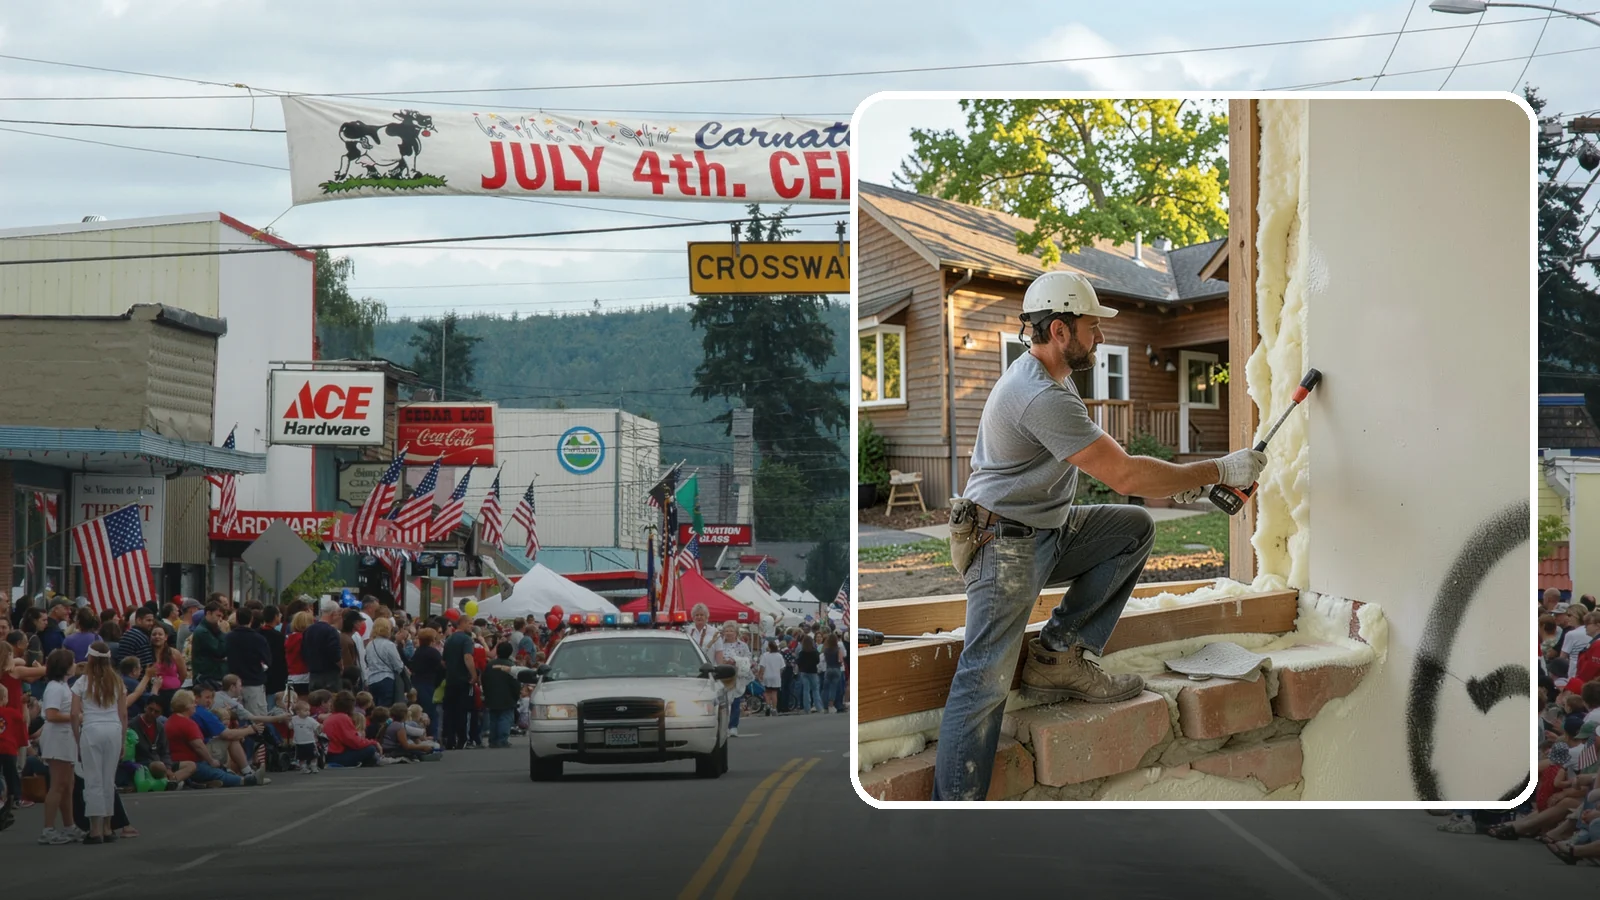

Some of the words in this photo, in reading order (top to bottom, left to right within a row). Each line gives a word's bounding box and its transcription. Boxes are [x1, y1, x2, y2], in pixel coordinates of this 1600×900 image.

[695, 121, 850, 150] Carnat
[481, 141, 605, 192] JULY
[632, 150, 746, 197] 4th.
[697, 254, 850, 280] CROSSWA
[283, 380, 373, 420] ACE
[405, 409, 452, 422] CEDAR
[461, 409, 485, 422] LOG
[283, 421, 371, 437] Hardware
[416, 428, 477, 447] Coca-Cola
[354, 467, 386, 480] Simpl
[96, 485, 124, 495] Vincent
[126, 486, 136, 495] de
[137, 486, 155, 495] Paul
[81, 503, 154, 522] THT
[212, 515, 331, 535] HARDARE
[688, 526, 742, 535] CRNATION
[699, 535, 730, 543] GLASS
